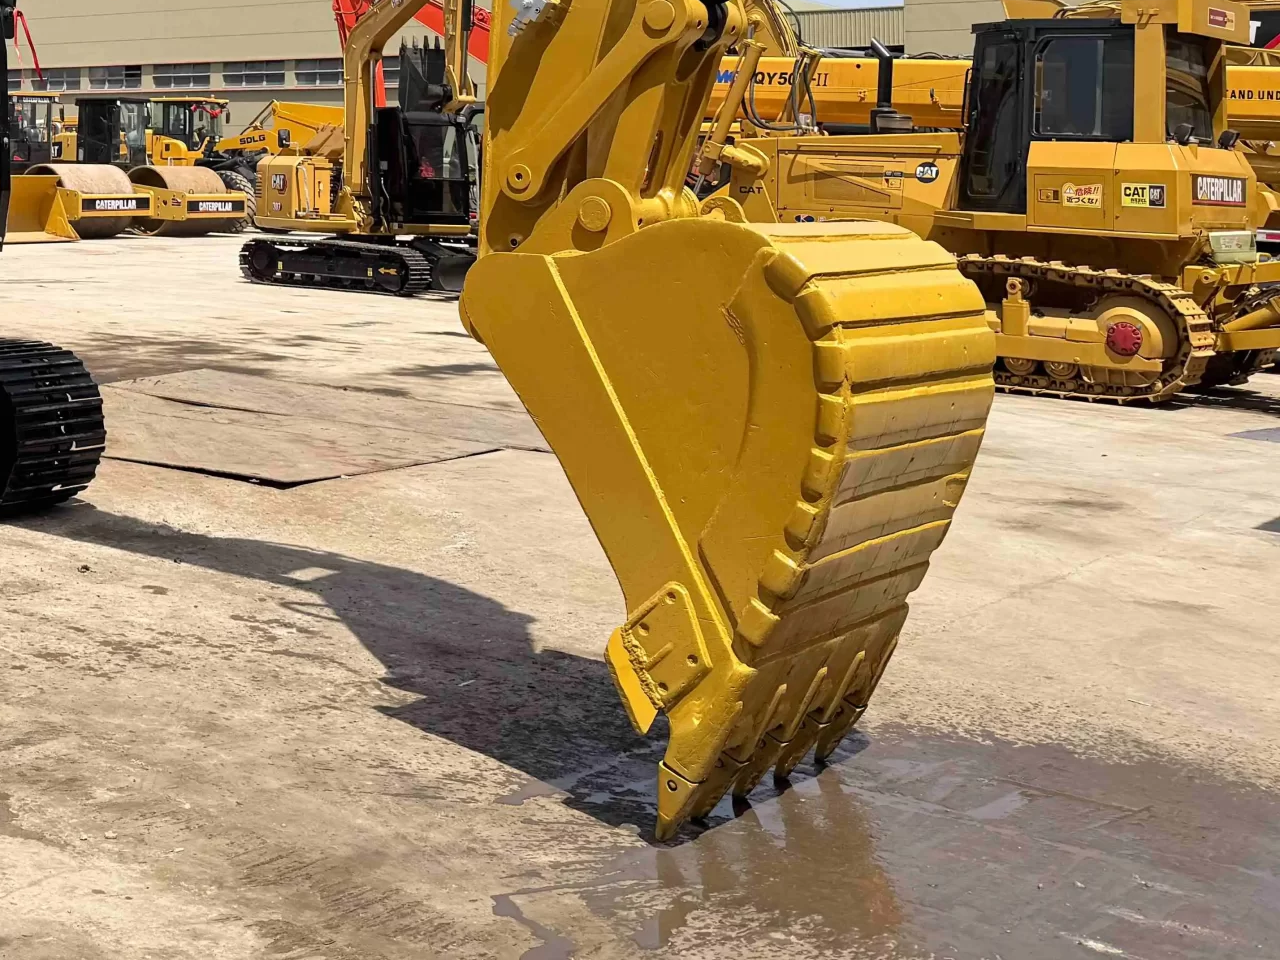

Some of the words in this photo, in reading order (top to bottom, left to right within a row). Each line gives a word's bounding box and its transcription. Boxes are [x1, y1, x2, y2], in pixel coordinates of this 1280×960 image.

[239, 134, 266, 145] SDLG
[915, 168, 939, 179] CAT
[271, 174, 284, 190] CAT
[739, 185, 764, 195] CAT
[1123, 186, 1147, 198] CAT
[1197, 176, 1243, 203] CATERPILLAR
[95, 199, 137, 210] CATERPILLAR
[198, 201, 233, 212] CATERPILLAR
